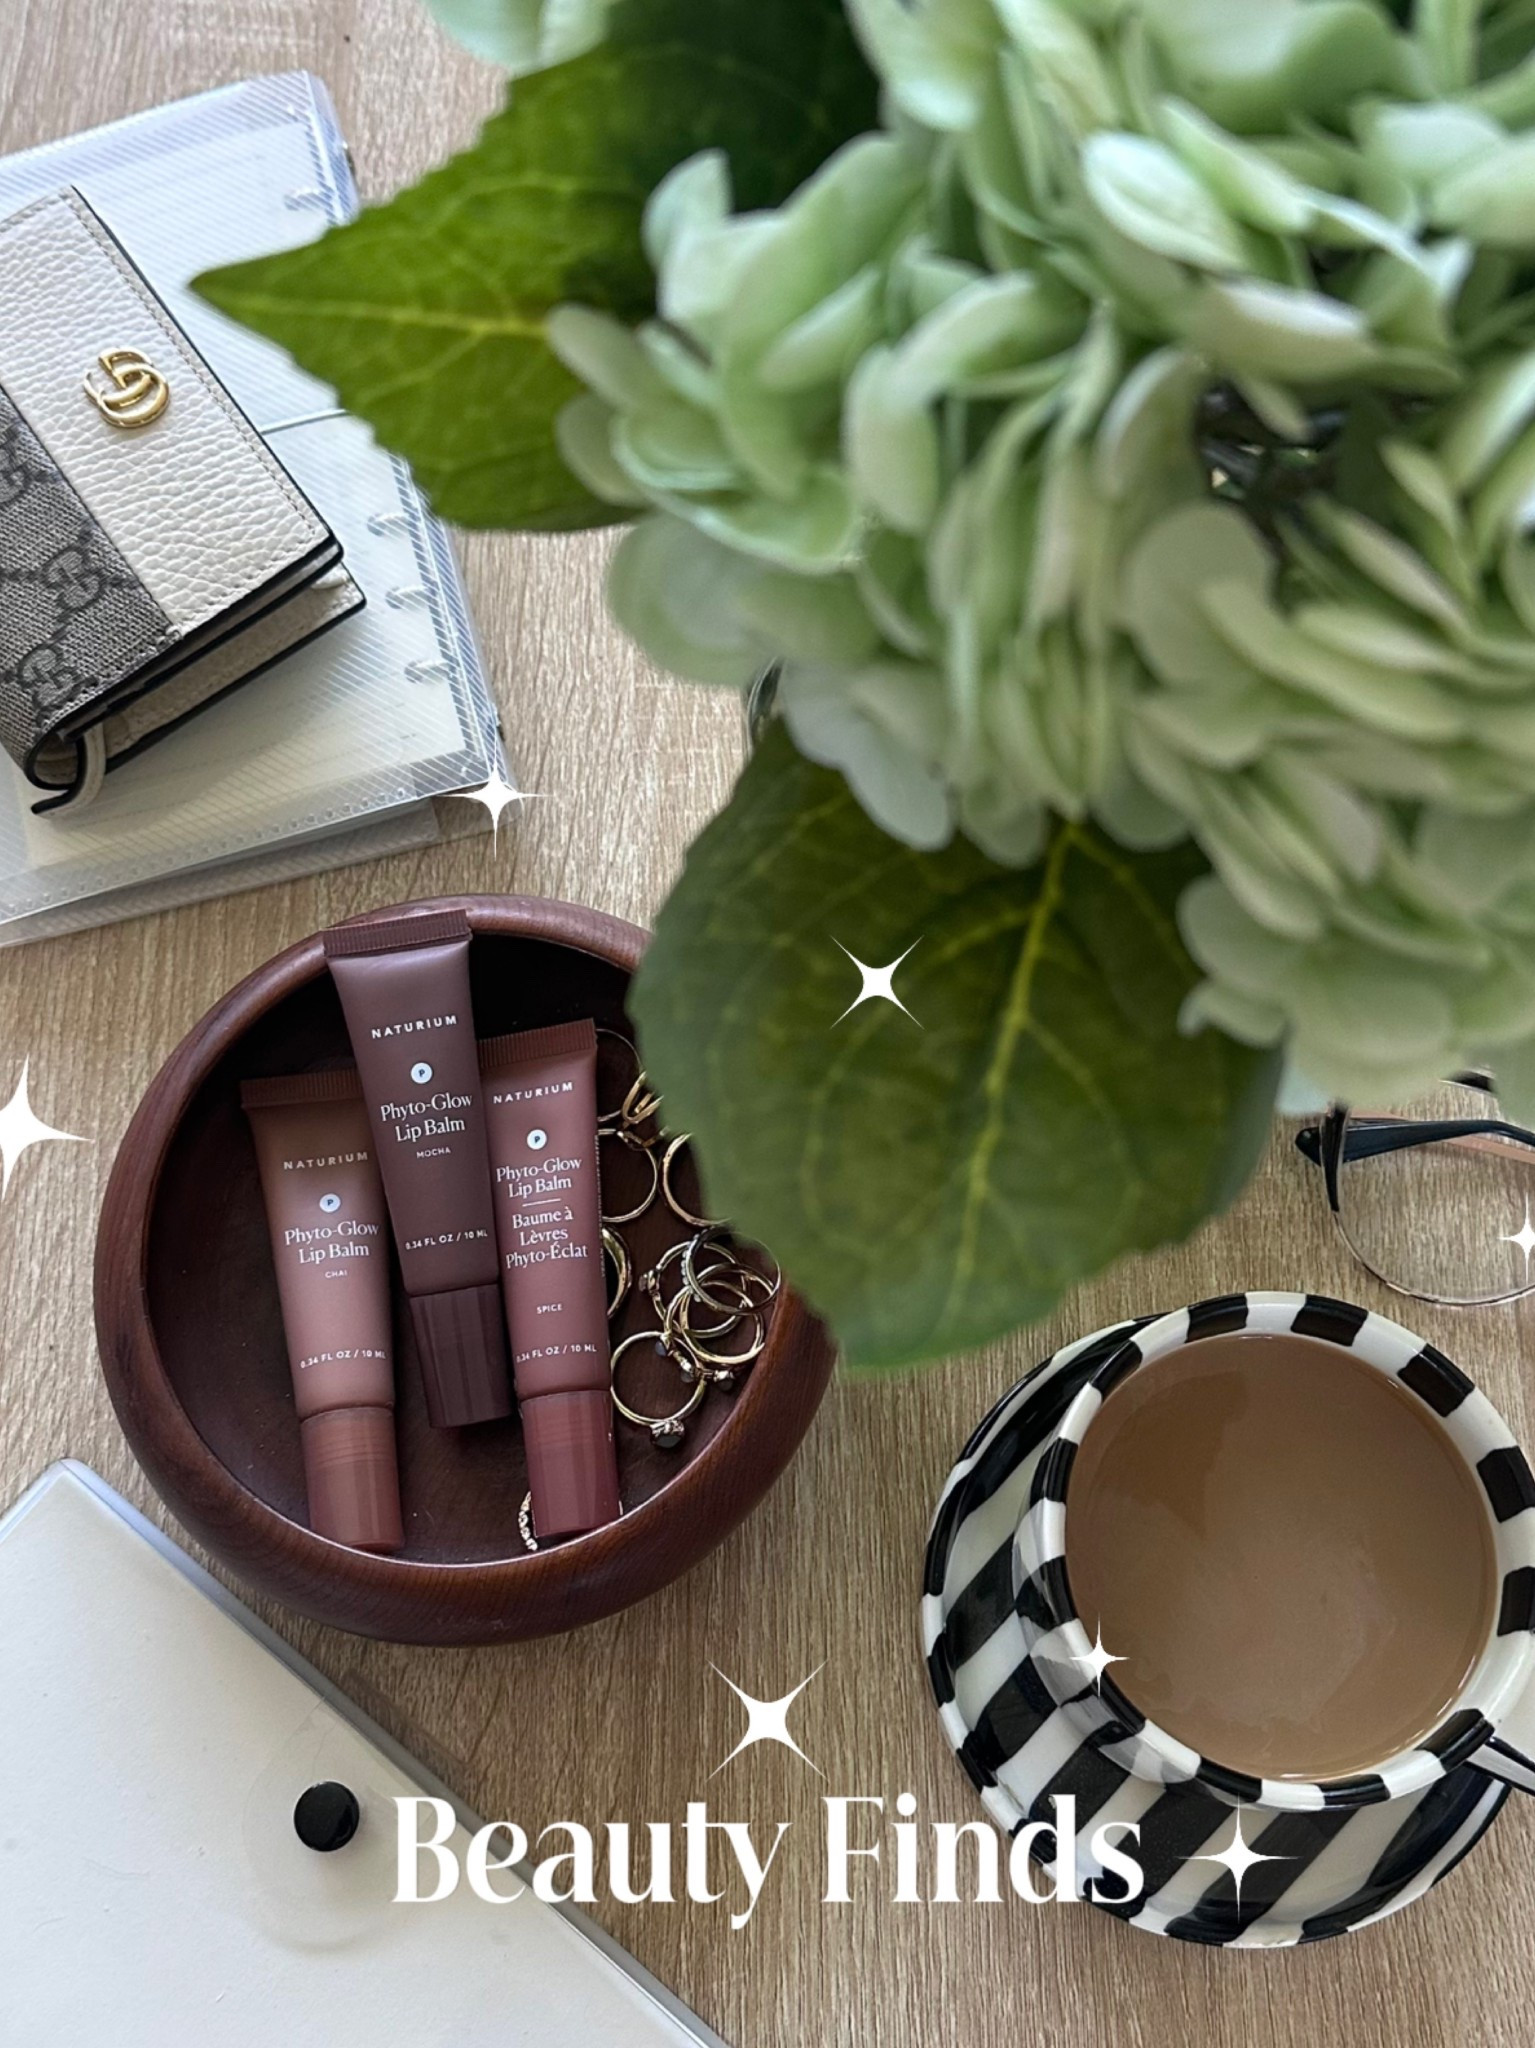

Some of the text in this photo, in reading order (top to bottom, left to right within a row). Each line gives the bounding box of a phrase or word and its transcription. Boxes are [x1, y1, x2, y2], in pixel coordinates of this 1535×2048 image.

[371, 1015, 457, 1039] NATURIUM
[493, 1081, 574, 1104] NATURIUM
[380, 1092, 472, 1122] Phyto-Glow
[395, 1116, 466, 1143] Lip Balm
[283, 1152, 368, 1170] NATURIUM
[416, 1146, 451, 1159] MOCHA
[496, 1157, 582, 1183] Phyto-Glow
[508, 1175, 572, 1199] Lip Balm
[512, 1206, 573, 1229] Baume à
[284, 1220, 379, 1246] Phyto-Glow
[424, 1237, 436, 1247] FL
[438, 1234, 454, 1243] OZ
[464, 1230, 475, 1239] 10
[476, 1229, 488, 1238] ML
[520, 1228, 569, 1246] Lèvres
[299, 1241, 369, 1265] Lip Balm
[506, 1241, 588, 1269] Phyto-Éclat
[325, 1270, 347, 1279] CHAI
[536, 1303, 563, 1314] SPICE
[321, 1353, 333, 1362] FL
[336, 1350, 351, 1359] OZ
[362, 1350, 372, 1358] 10
[532, 1349, 543, 1358] FL
[545, 1346, 560, 1355] OZ
[570, 1344, 581, 1352] 10
[584, 1344, 597, 1352] ML
